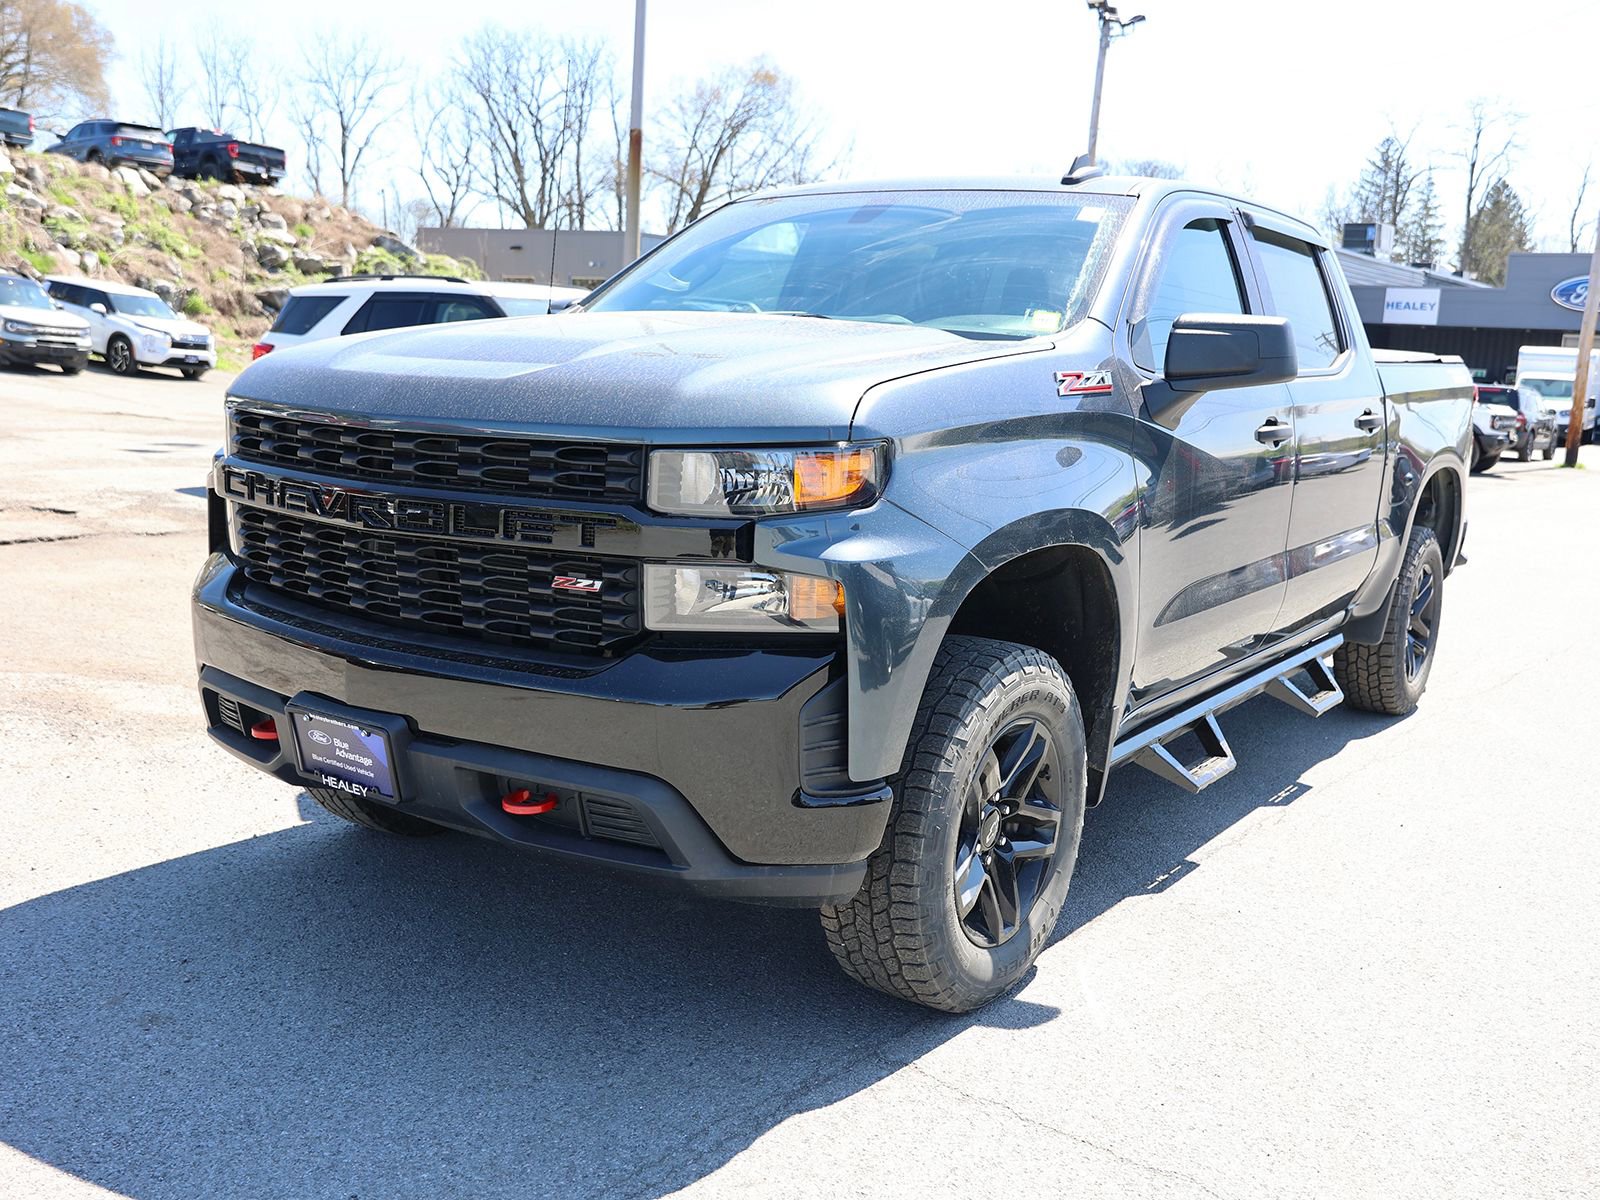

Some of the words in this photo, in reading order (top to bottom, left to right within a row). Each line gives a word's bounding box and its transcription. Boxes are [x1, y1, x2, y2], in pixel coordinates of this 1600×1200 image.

[1386, 301, 1437, 311] HEALEY
[1054, 370, 1114, 396] Z71
[225, 469, 617, 548] CHEVROLET
[552, 576, 602, 592] Z71
[333, 738, 349, 750] Blue
[311, 753, 322, 762] Blue
[323, 757, 343, 768] Certified
[343, 763, 357, 773] Used
[357, 767, 375, 778] Vehicle
[335, 748, 373, 766] Advantage
[322, 774, 368, 797] HEALEY
